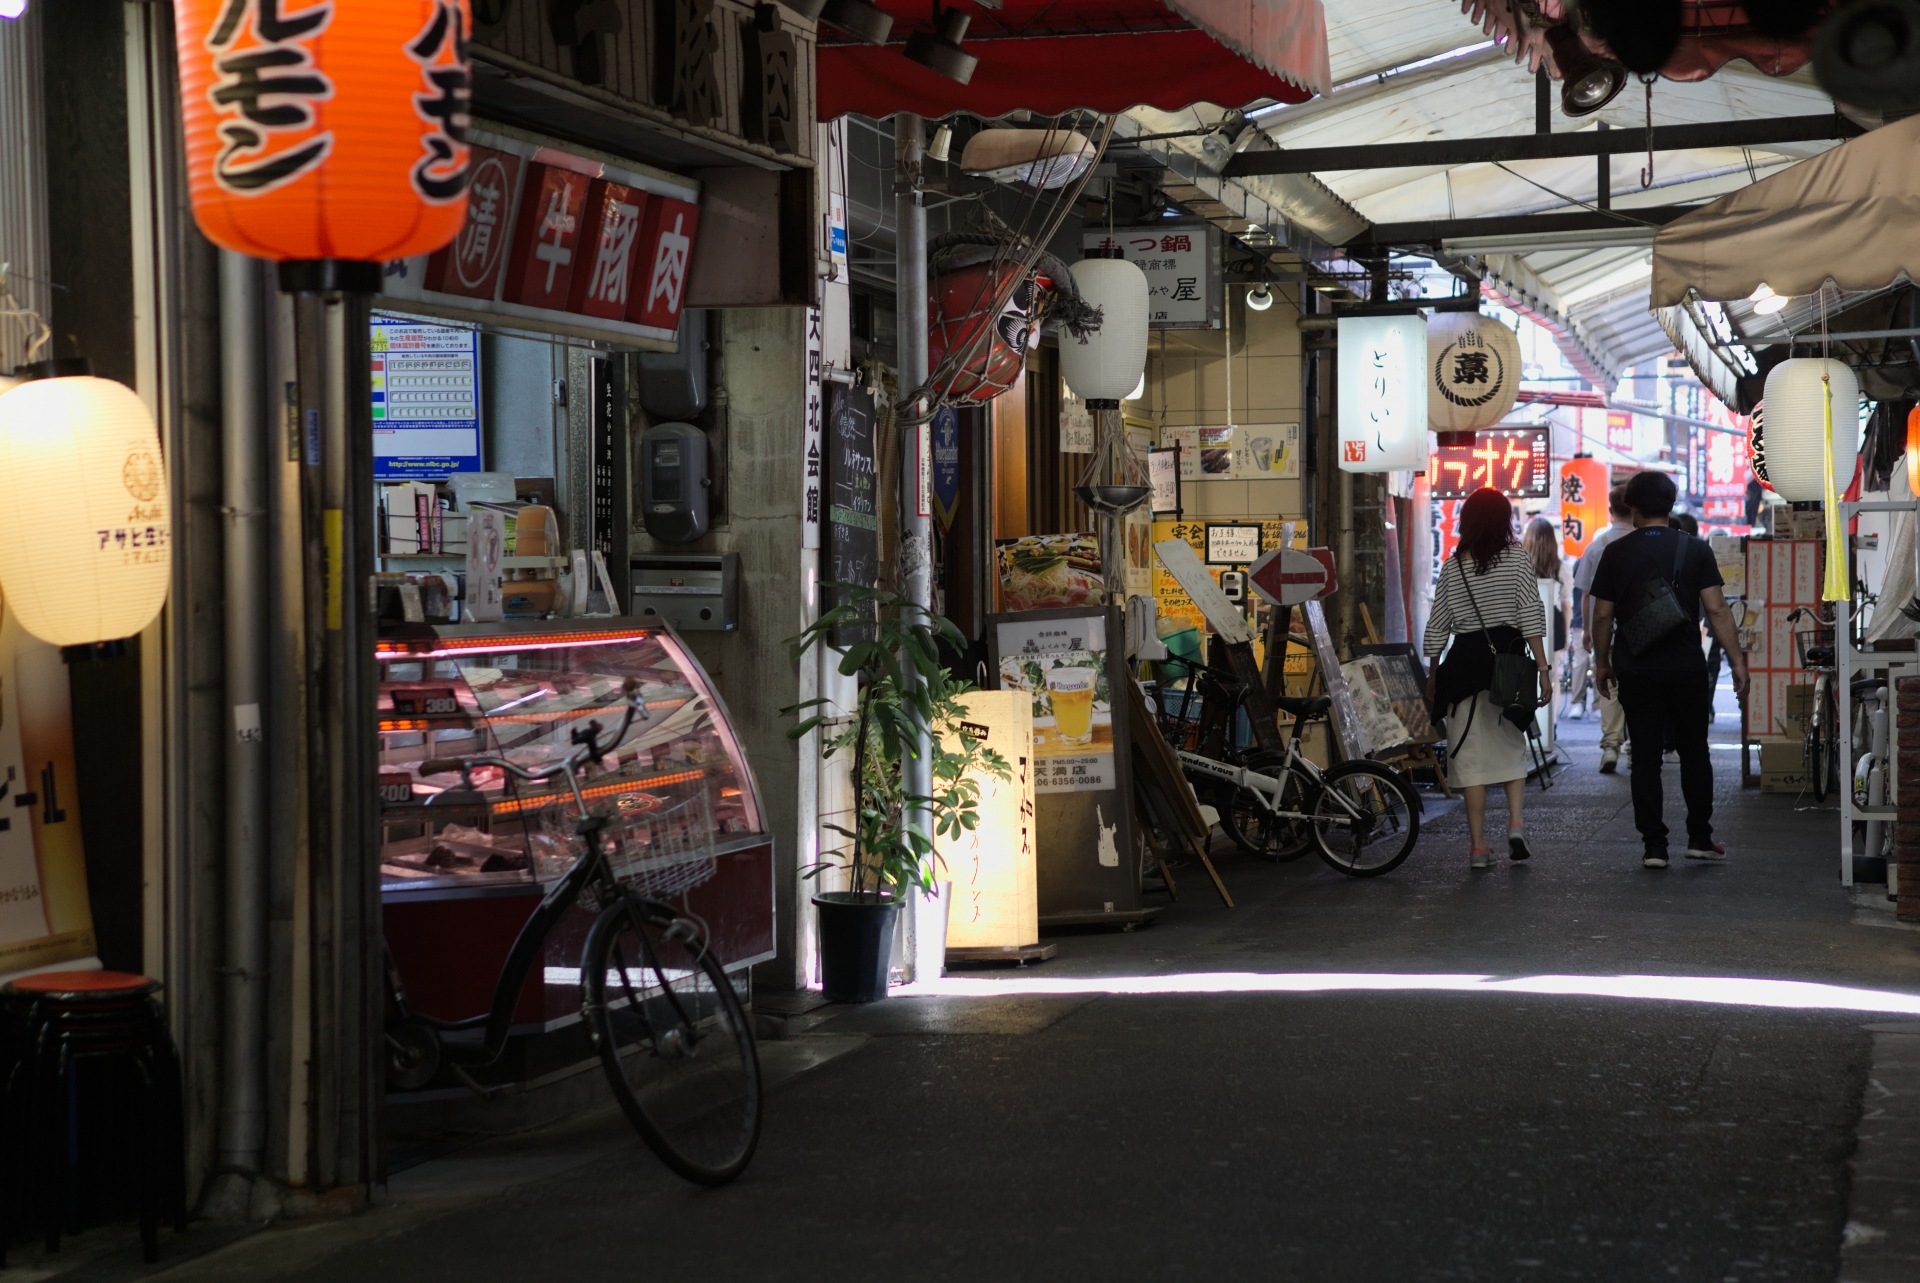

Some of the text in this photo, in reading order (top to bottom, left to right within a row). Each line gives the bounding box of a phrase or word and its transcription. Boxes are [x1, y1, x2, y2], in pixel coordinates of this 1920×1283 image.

[1170, 276, 1202, 302] 屋
[1370, 349, 1390, 453] とりいし
[1561, 473, 1584, 542] 焼肉
[1171, 524, 1204, 540] 宴会
[1262, 522, 1283, 530] 満本店
[1213, 547, 1248, 557] できません
[1068, 637, 1085, 651] 屋
[424, 698, 457, 714] 380
[1211, 763, 1235, 777] vous
